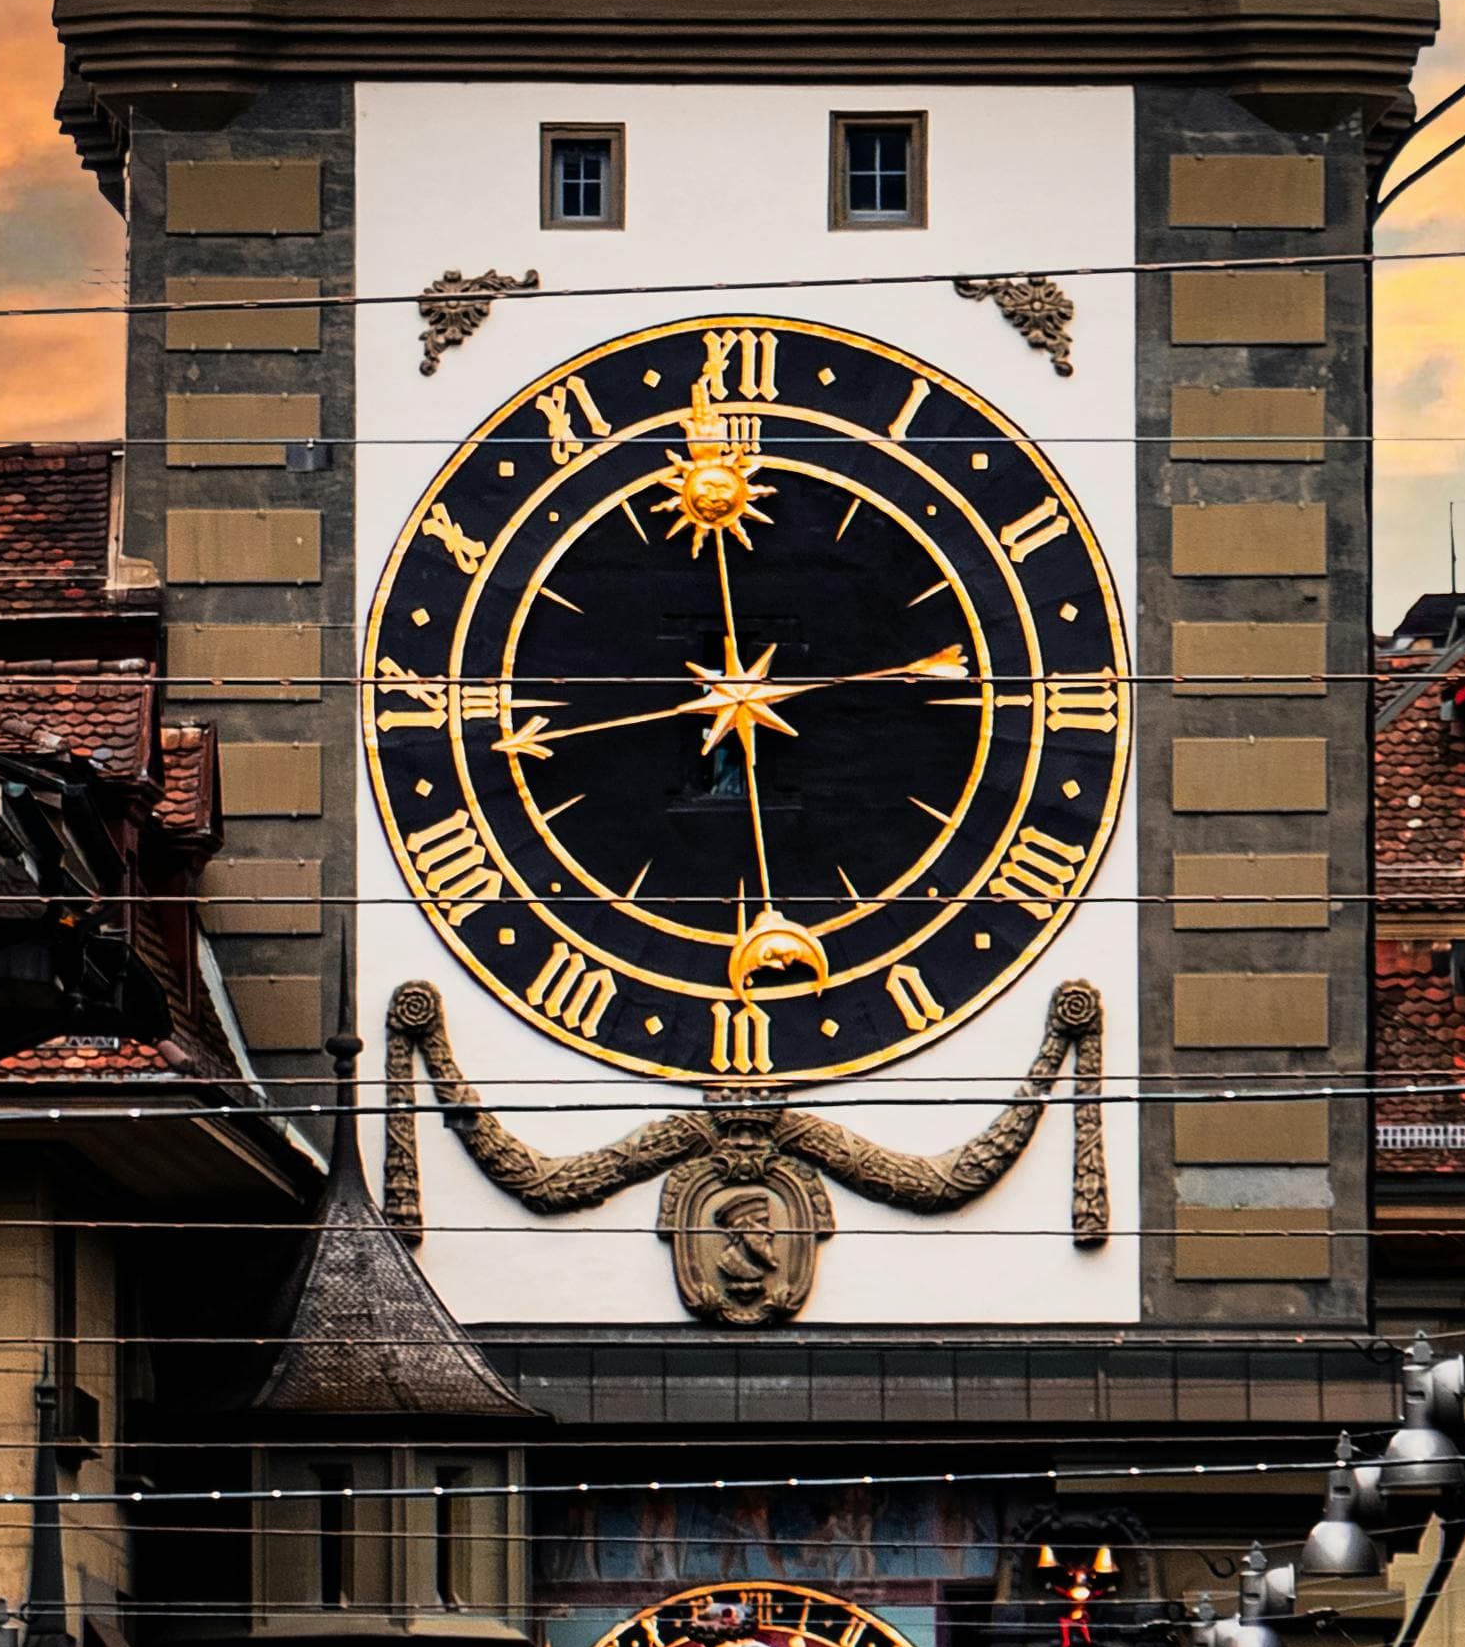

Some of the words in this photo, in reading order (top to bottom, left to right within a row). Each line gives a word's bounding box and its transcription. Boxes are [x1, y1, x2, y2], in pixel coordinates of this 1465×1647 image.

[536, 374, 612, 465] XI
[421, 502, 487, 575] X
[999, 495, 1070, 563] II
[1045, 666, 1118, 733] III
